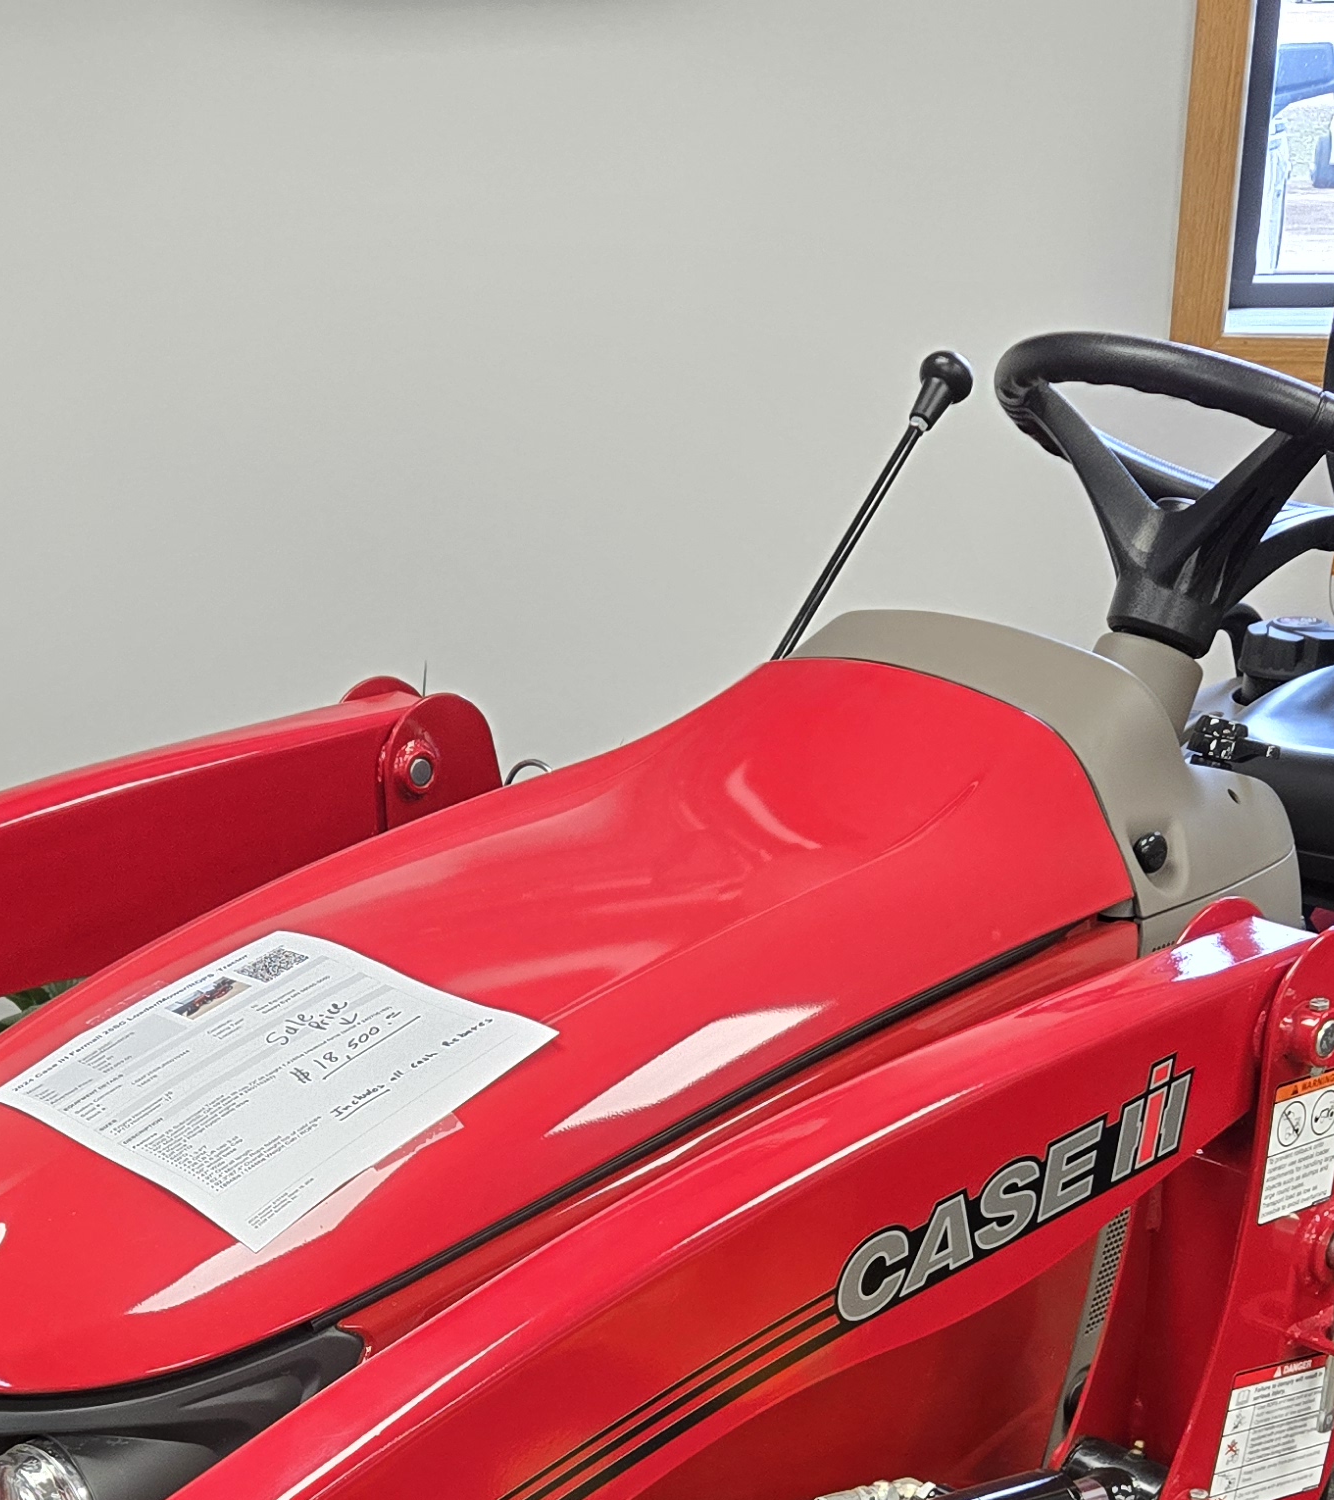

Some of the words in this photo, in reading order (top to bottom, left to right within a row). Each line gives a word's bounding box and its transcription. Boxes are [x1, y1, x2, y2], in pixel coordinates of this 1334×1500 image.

[265, 1013, 314, 1046] Sale
[11, 1077, 36, 1092] 2024
[33, 1062, 60, 1078] Case
[66, 1034, 105, 1056] Farmall
[388, 1070, 405, 1082] all
[837, 1119, 1105, 1322] CASE
[1282, 1358, 1312, 1375] DANGER
